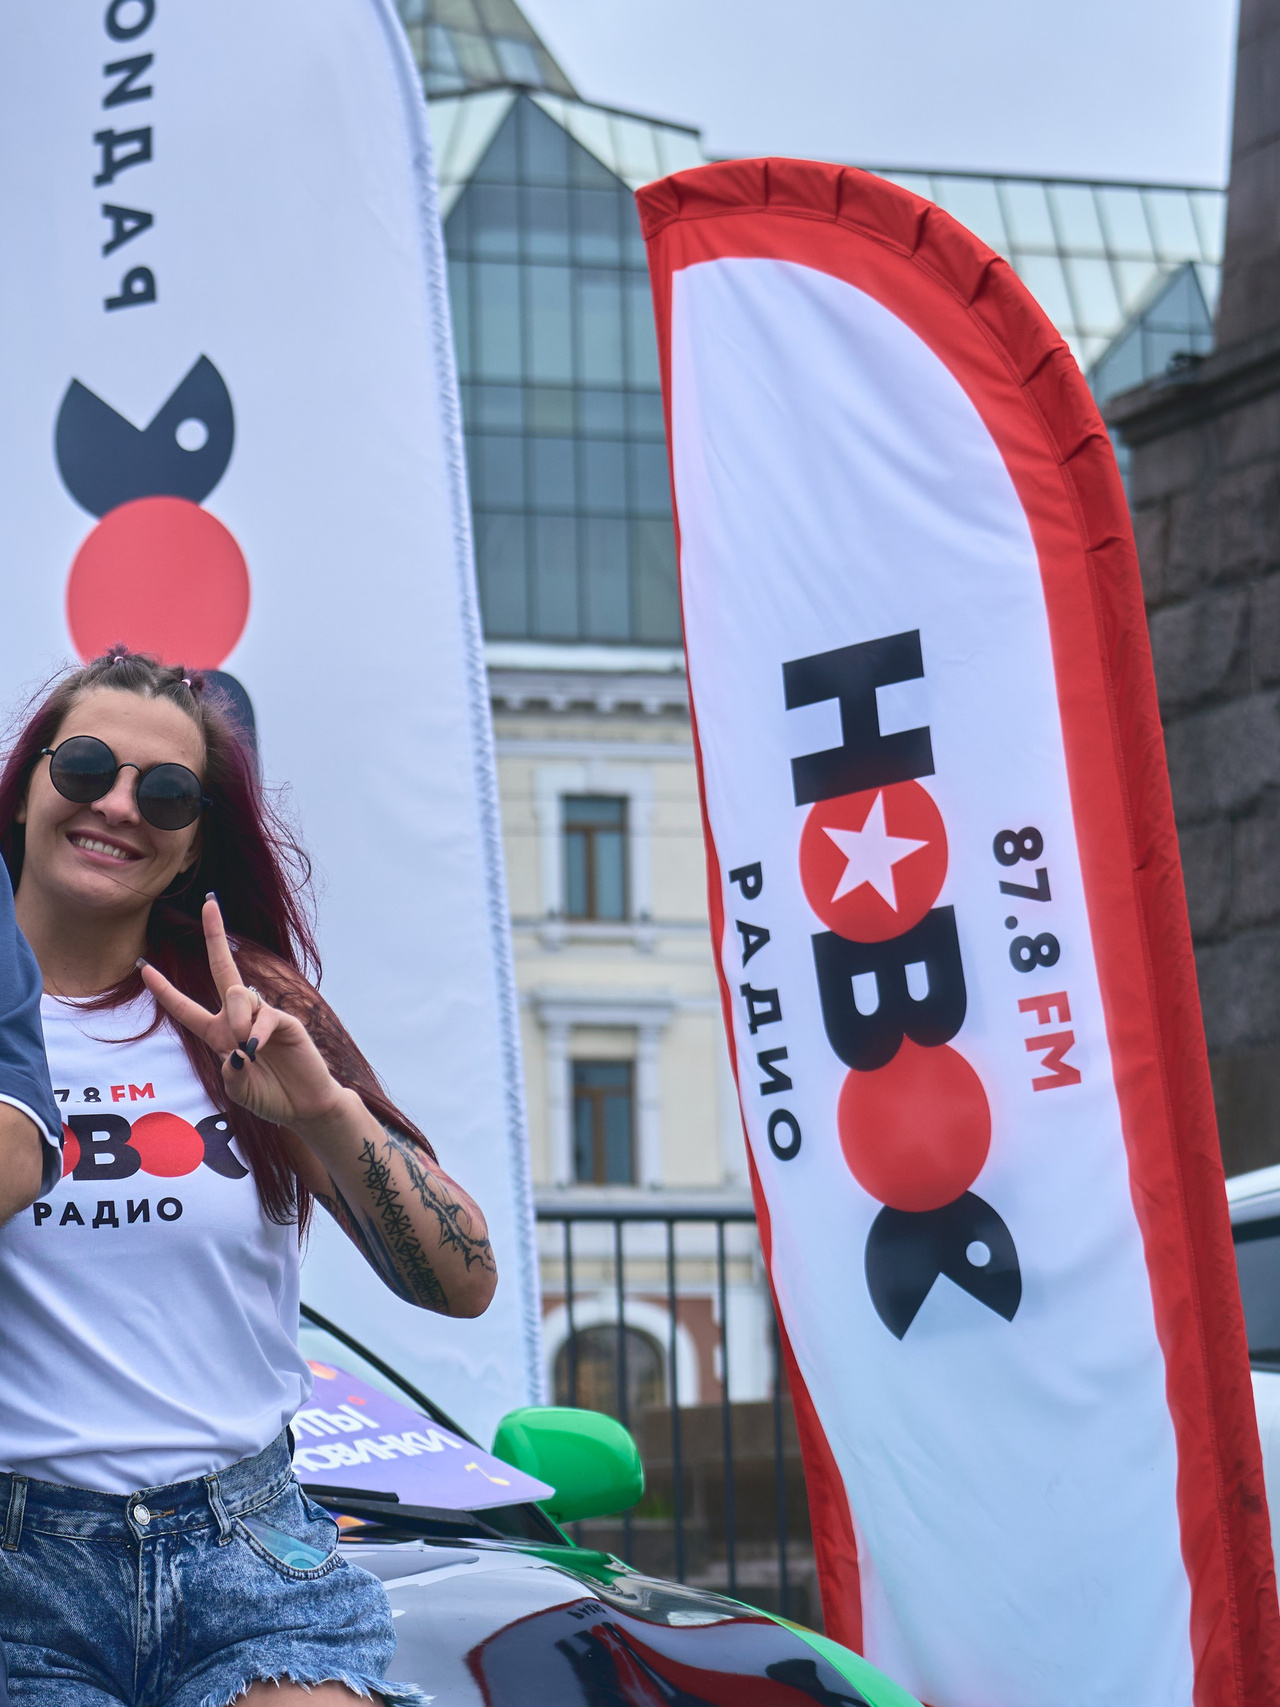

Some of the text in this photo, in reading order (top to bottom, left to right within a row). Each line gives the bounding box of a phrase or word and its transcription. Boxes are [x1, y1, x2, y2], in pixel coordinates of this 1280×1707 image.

[728, 860, 802, 1162] РАДИО
[992, 826, 1082, 1093] 87.8 FM
[110, 1082, 156, 1103] FM
[33, 1197, 184, 1229] РАДИО
